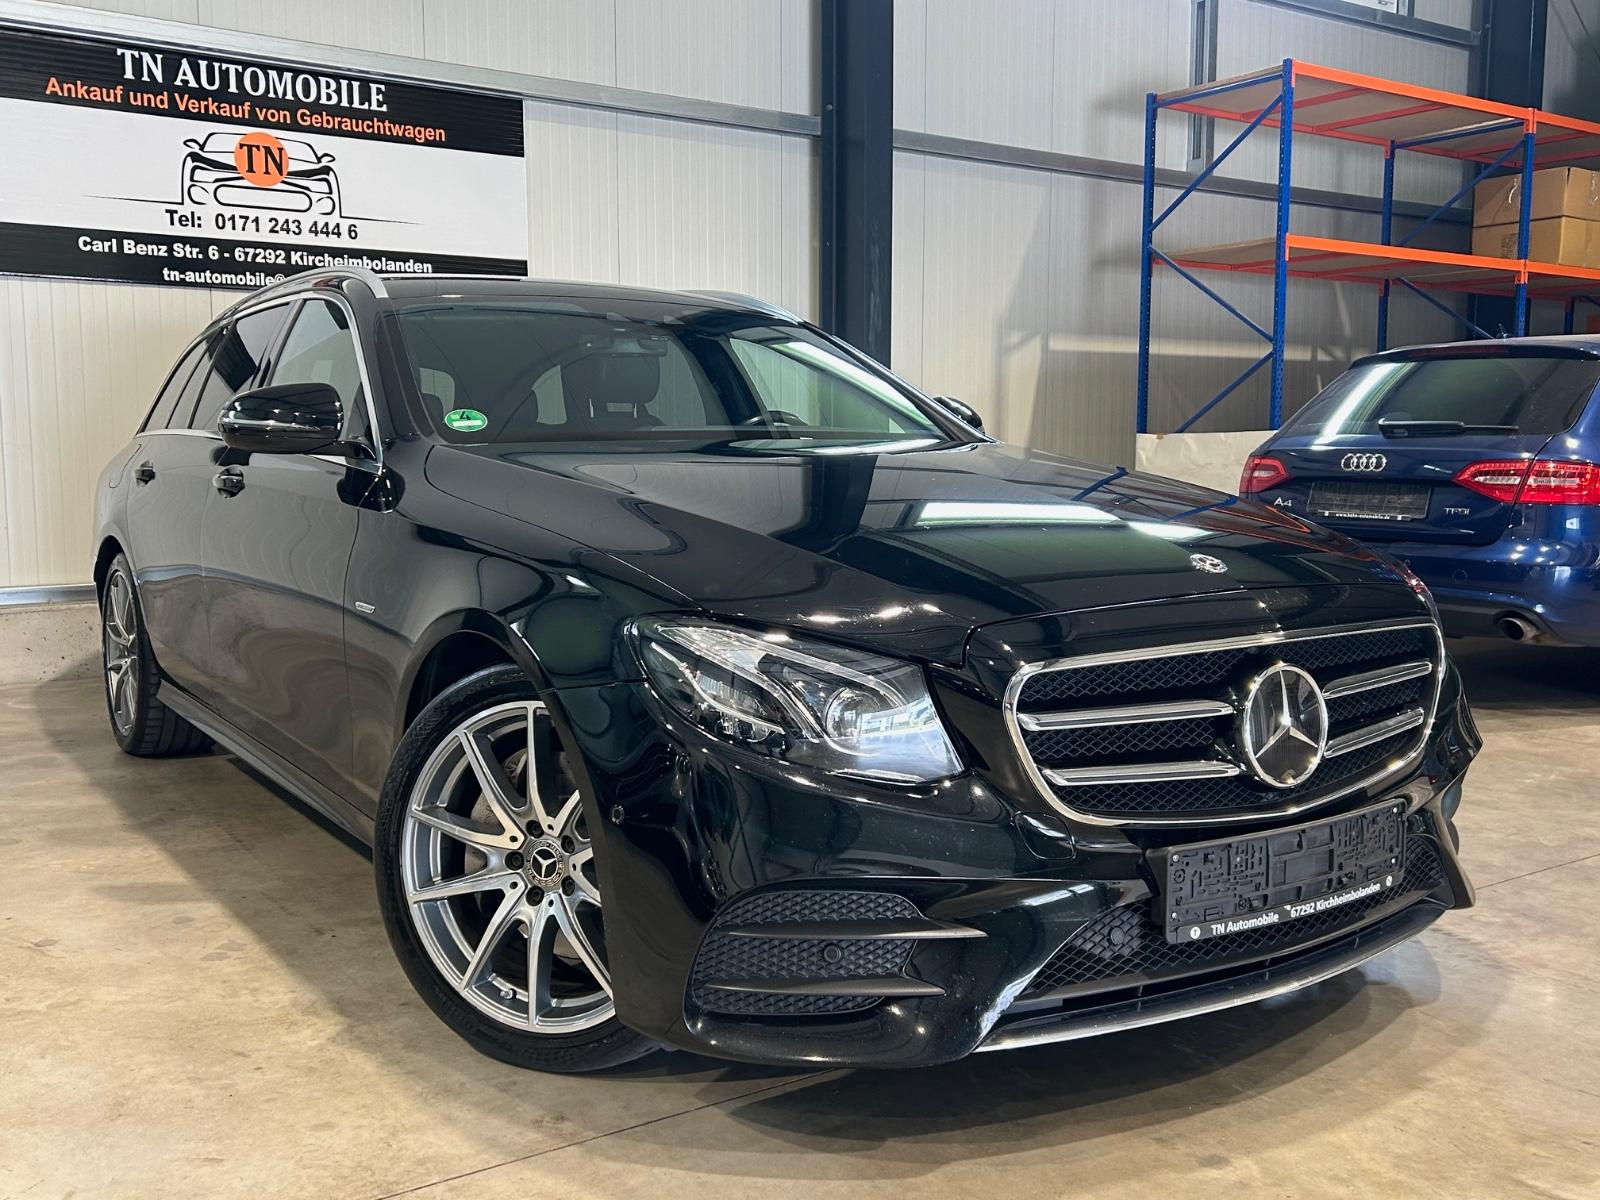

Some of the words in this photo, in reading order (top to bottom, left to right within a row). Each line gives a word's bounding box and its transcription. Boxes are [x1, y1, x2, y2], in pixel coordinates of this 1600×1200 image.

[117, 48, 163, 83] TN
[174, 57, 388, 112] AUTOMOBILE
[45, 77, 123, 103] Ankauf
[129, 91, 168, 109] und
[174, 93, 251, 119] Verkauf
[255, 107, 291, 124] von
[296, 108, 446, 143] Gebrauchtwagen
[239, 143, 284, 176] TN
[165, 209, 202, 228] Tel:
[214, 213, 260, 232] 0171
[268, 217, 302, 236] 243
[308, 220, 342, 239] 444
[348, 223, 358, 240] 6
[78, 236, 117, 253] Carl
[123, 239, 168, 256] Benz
[173, 242, 203, 259] Str.
[208, 245, 219, 260] 6
[234, 247, 286, 264] 67292
[459, 411, 471, 420] 4
[1273, 496, 1292, 507] A4
[1211, 923, 1225, 935] TN
[1226, 912, 1279, 933] Automobile
[1290, 902, 1315, 918] 67292
[1316, 883, 1381, 911] Kirchheimbolanden
